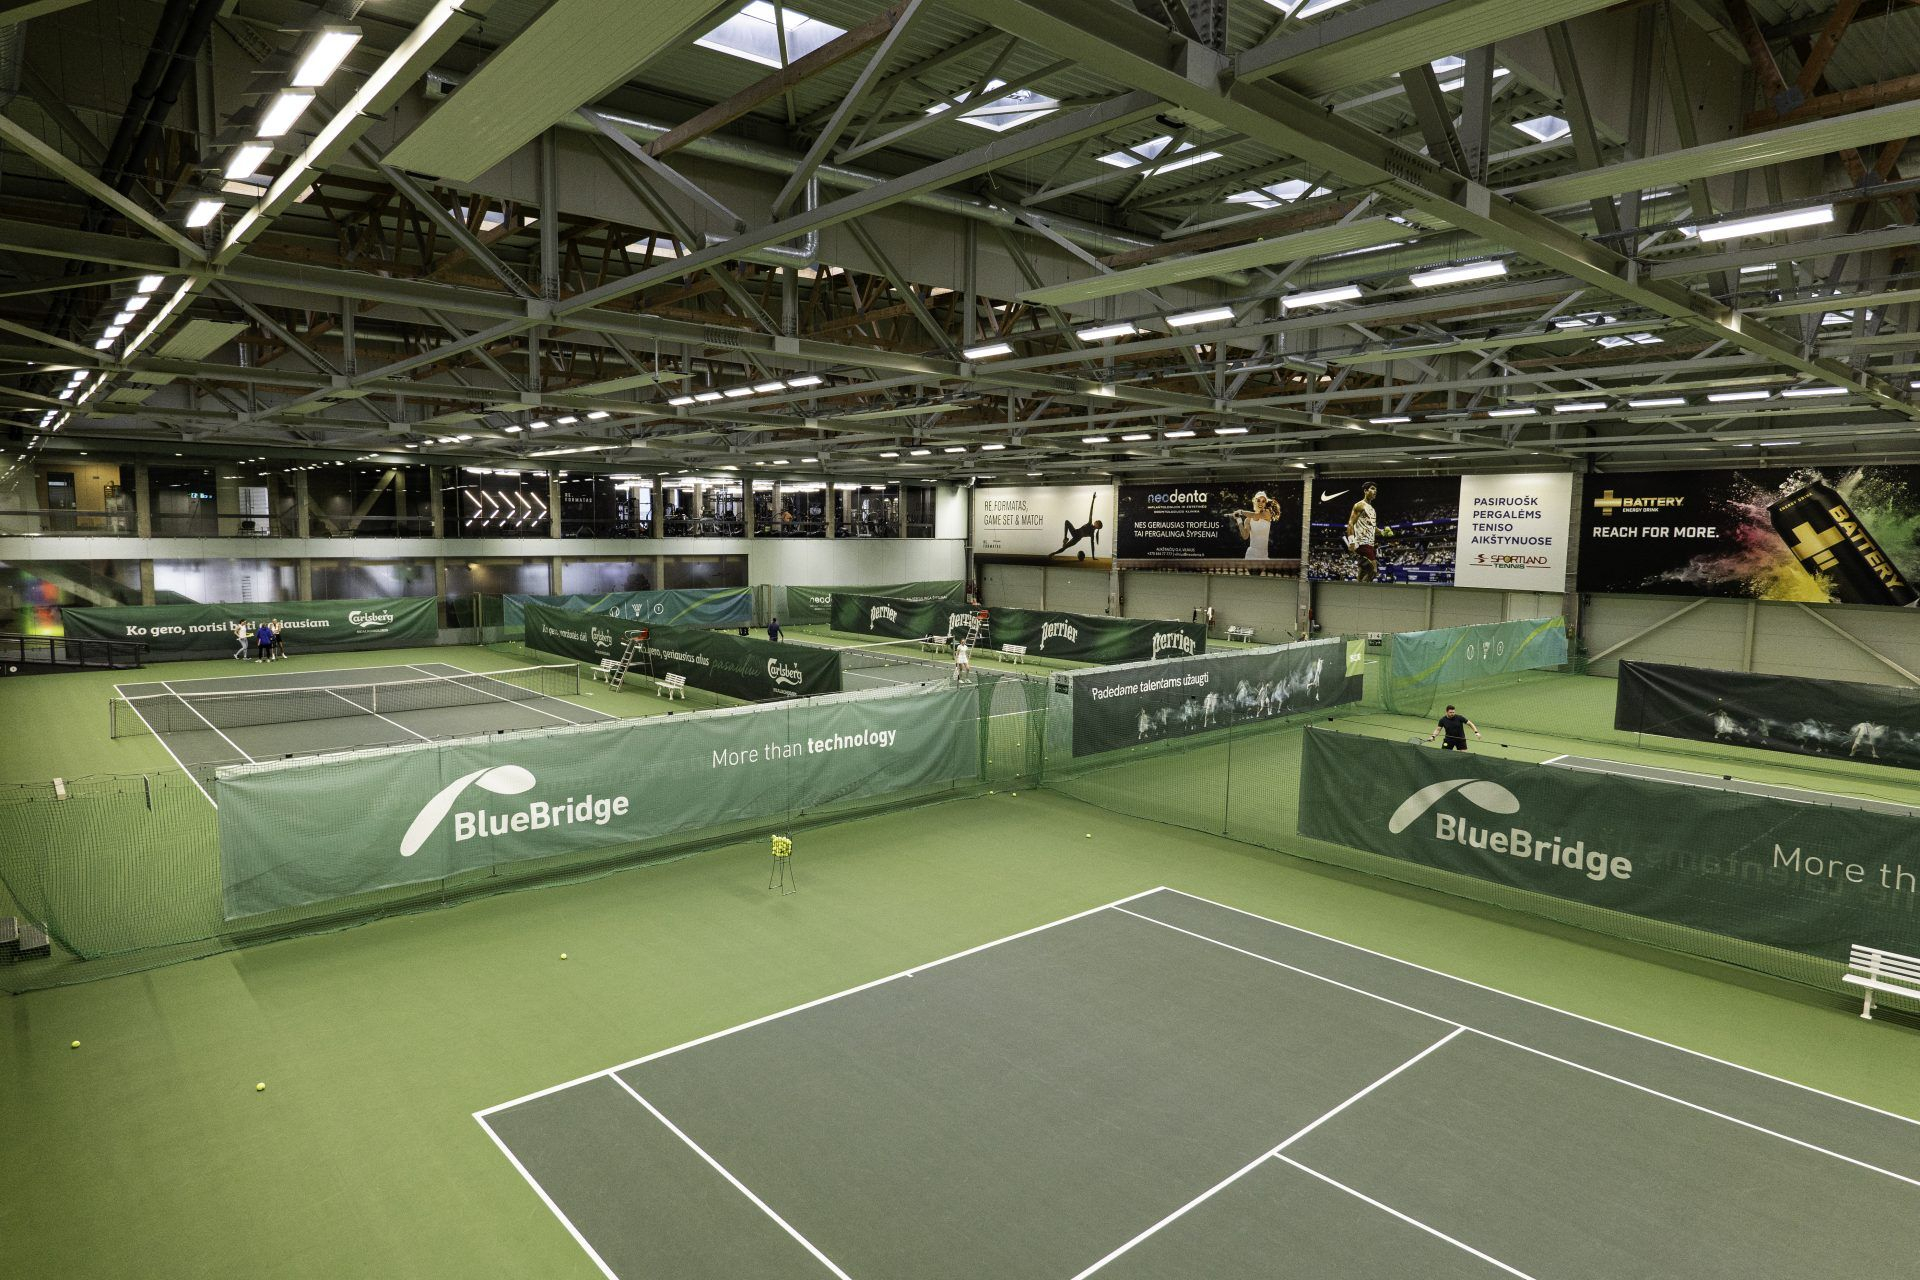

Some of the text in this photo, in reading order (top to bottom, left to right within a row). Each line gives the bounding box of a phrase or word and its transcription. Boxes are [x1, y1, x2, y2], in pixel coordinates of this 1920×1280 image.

[1148, 489, 1207, 503] neodenta
[1474, 495, 1538, 506] PASIRUOŠK
[1623, 497, 1685, 507] BATTERY
[984, 514, 1044, 526] GAME SET & MATCH
[1473, 509, 1542, 519] PERGALĖMS
[1134, 521, 1147, 529] NES
[1186, 520, 1220, 529] TROFĖJUS
[1472, 523, 1513, 532] TENISO
[1134, 530, 1144, 538] TAI
[1593, 526, 1720, 538] REACH FOR MORE.
[1471, 534, 1552, 546] AIKŠTYNUOSE
[1828, 505, 1905, 588] BATTERY
[1490, 555, 1548, 564] SPORTLAND
[810, 593, 833, 604] neod
[349, 610, 394, 627] Carlsberg
[126, 625, 147, 636] Ko
[150, 625, 186, 637] gero,
[189, 621, 227, 634] norisi
[230, 621, 256, 632] bti
[591, 626, 613, 648] Carlsberg
[663, 649, 695, 663] geriausias
[696, 653, 710, 666] alus
[767, 657, 803, 686] Carlsberg
[1092, 672, 1209, 701] Padedame talentams užaugti
[712, 728, 897, 769] More than technology
[454, 794, 629, 842] BlueBridge
[1436, 812, 1633, 882] BlueBridge
[1773, 842, 1866, 883] More
